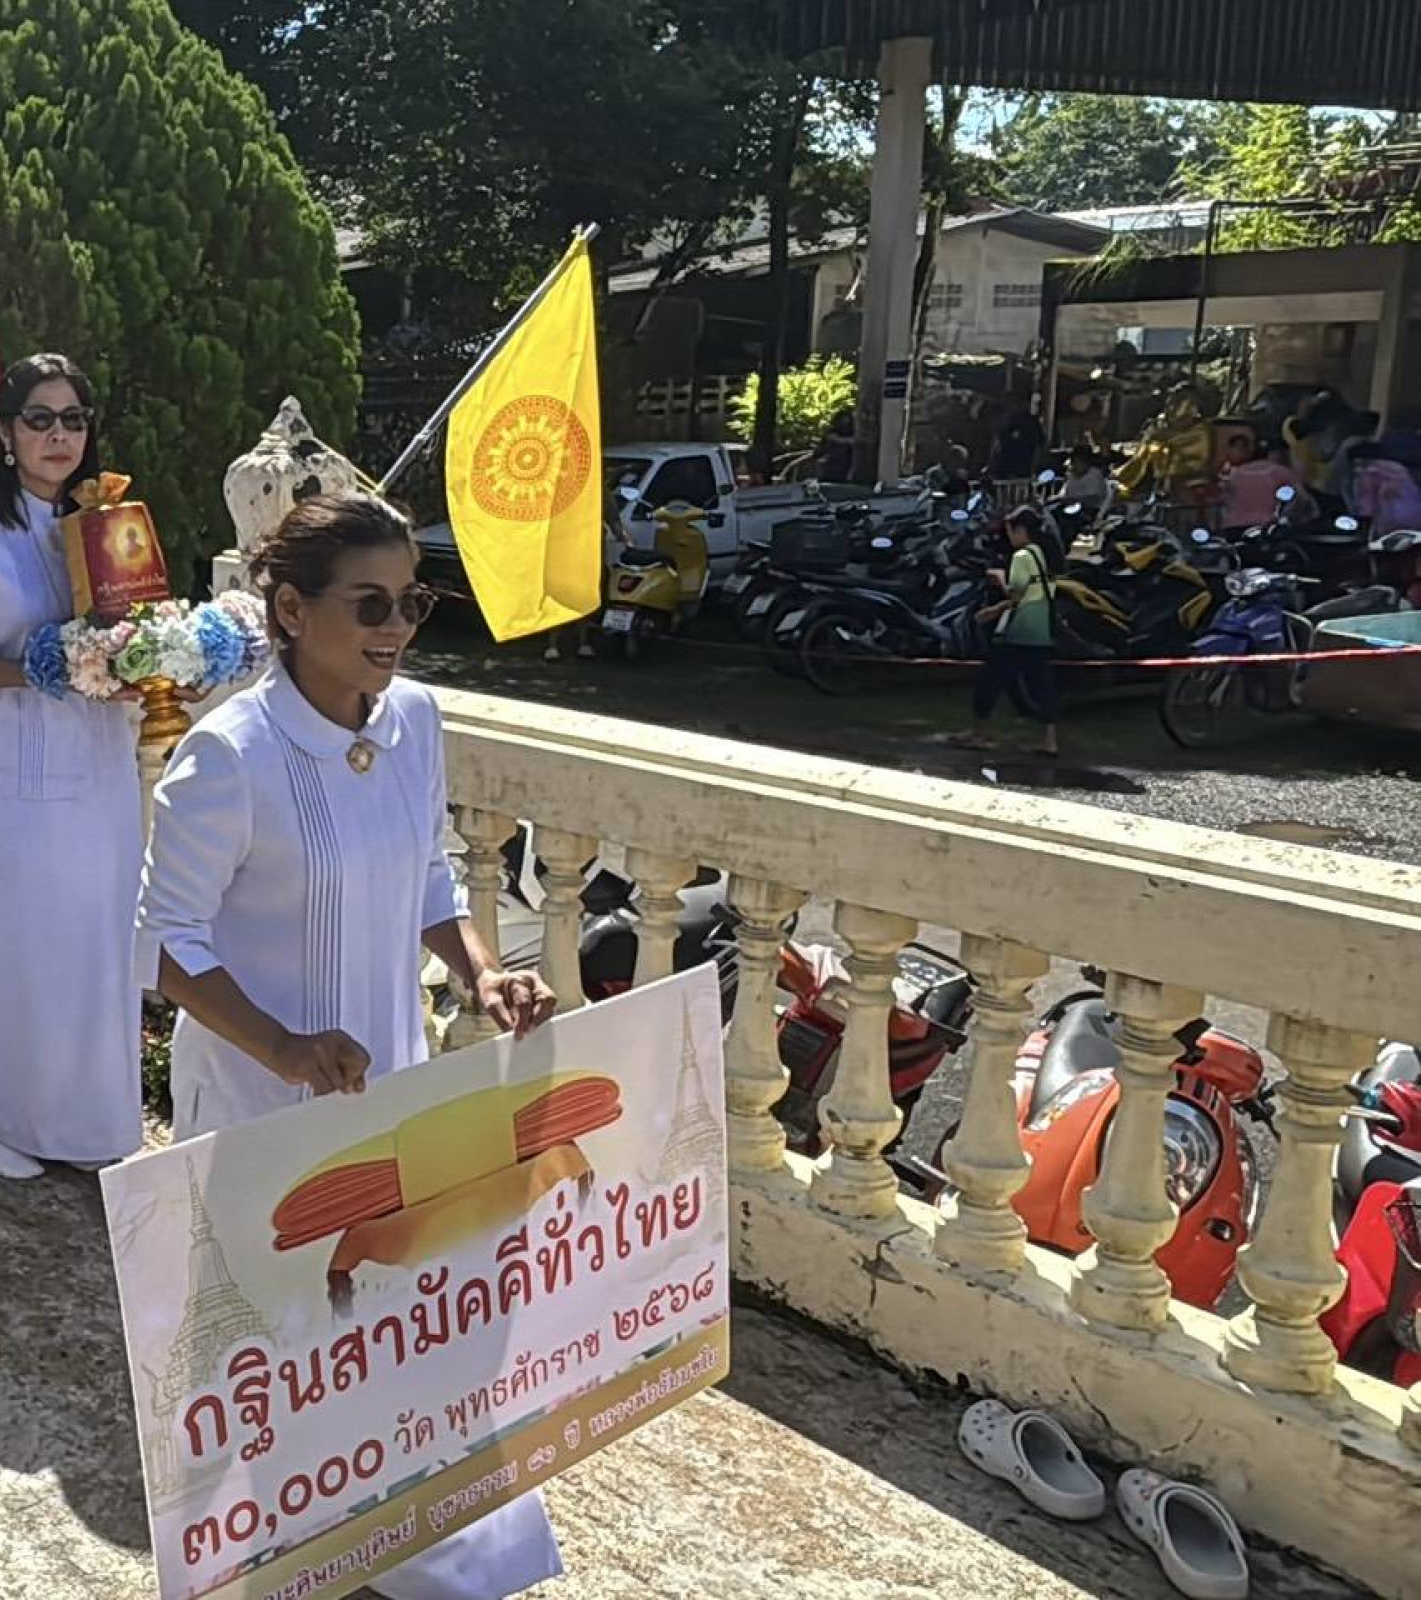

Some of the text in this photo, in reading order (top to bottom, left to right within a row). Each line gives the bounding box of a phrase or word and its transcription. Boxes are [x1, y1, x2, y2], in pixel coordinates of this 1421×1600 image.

[183, 1177, 700, 1462] กฐินสามัคคีทั่วไทย
[183, 1261, 715, 1565] ๓๐,๐๐๐ วัด พุทธศักราช ๒๕๖๘
